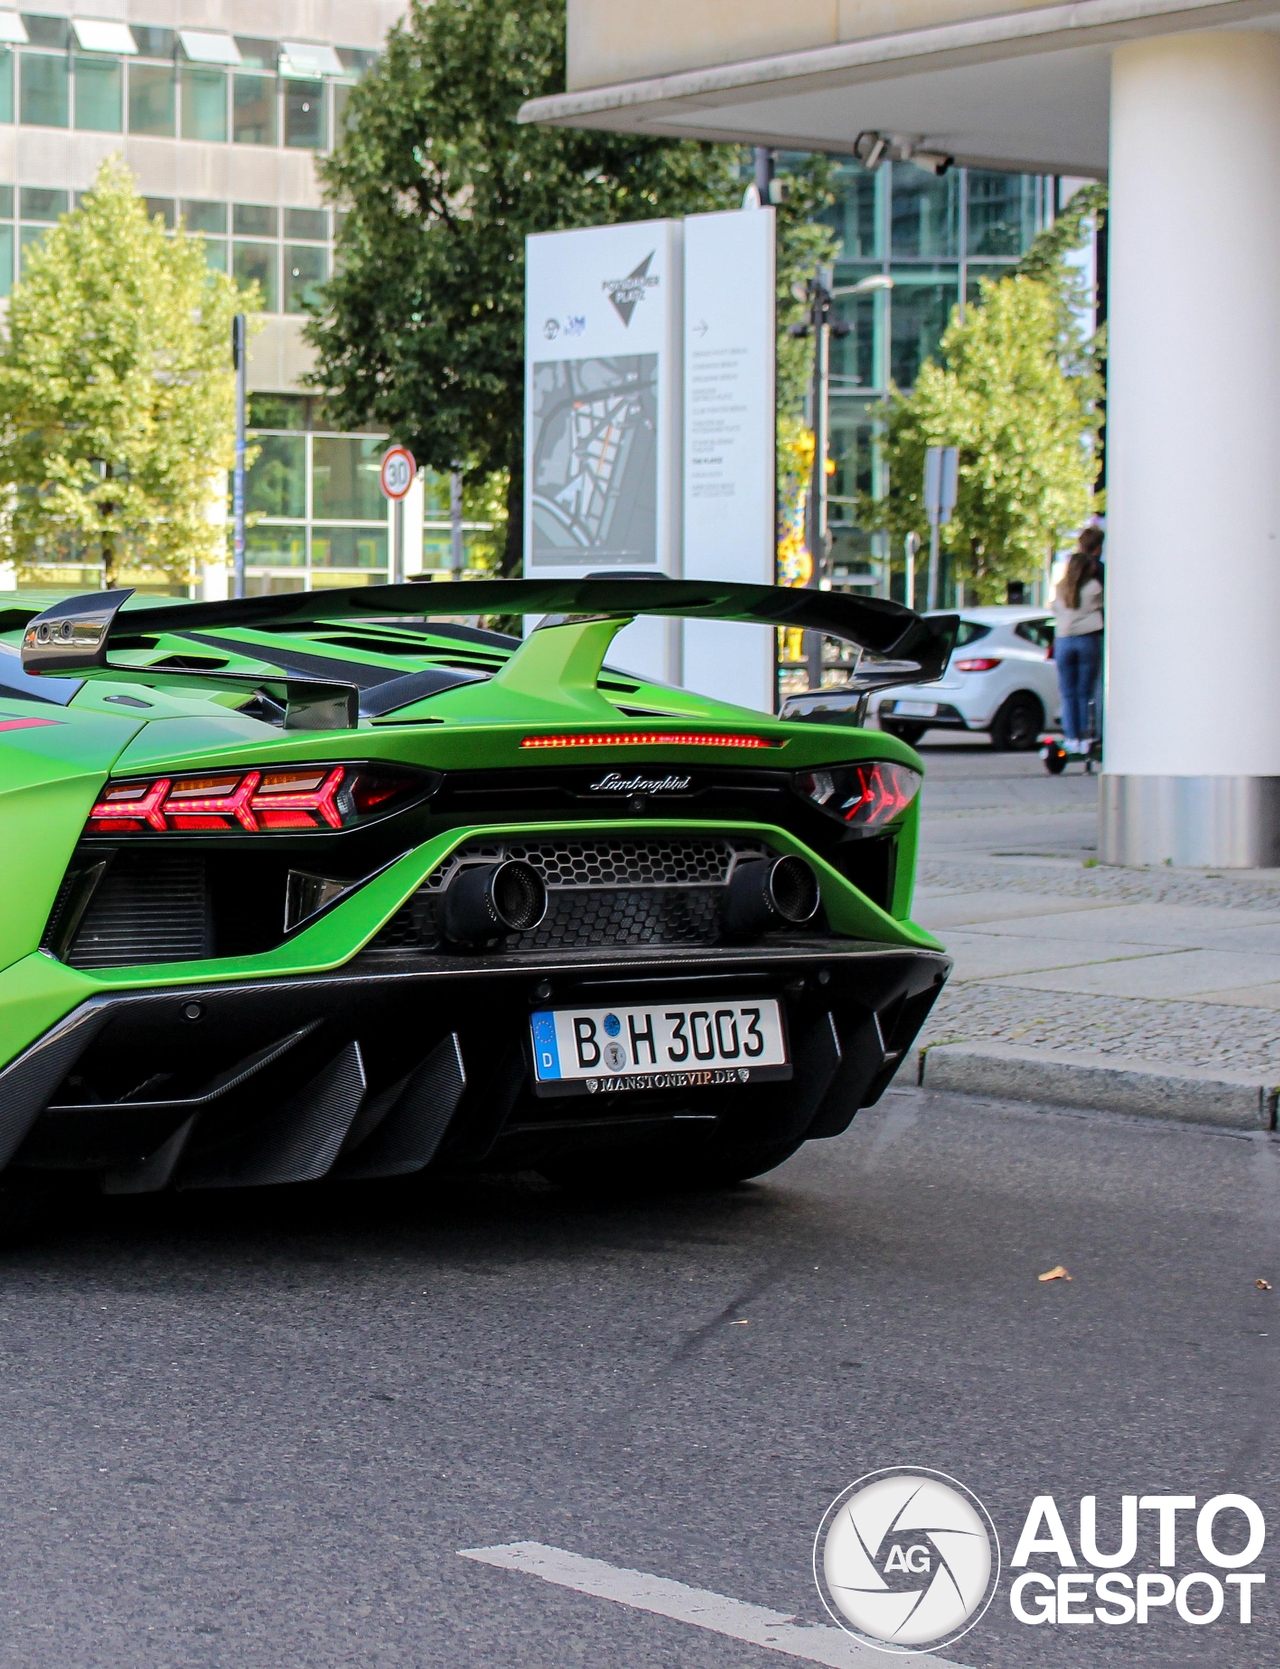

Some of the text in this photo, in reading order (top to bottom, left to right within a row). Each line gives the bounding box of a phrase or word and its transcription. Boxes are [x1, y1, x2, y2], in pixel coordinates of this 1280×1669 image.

[389, 461, 407, 486] 30
[590, 772, 691, 794] Lamborghini
[572, 1007, 765, 1068] B H 3003
[543, 1053, 553, 1068] D
[601, 1069, 736, 1093] MANSTONEVIP.DE
